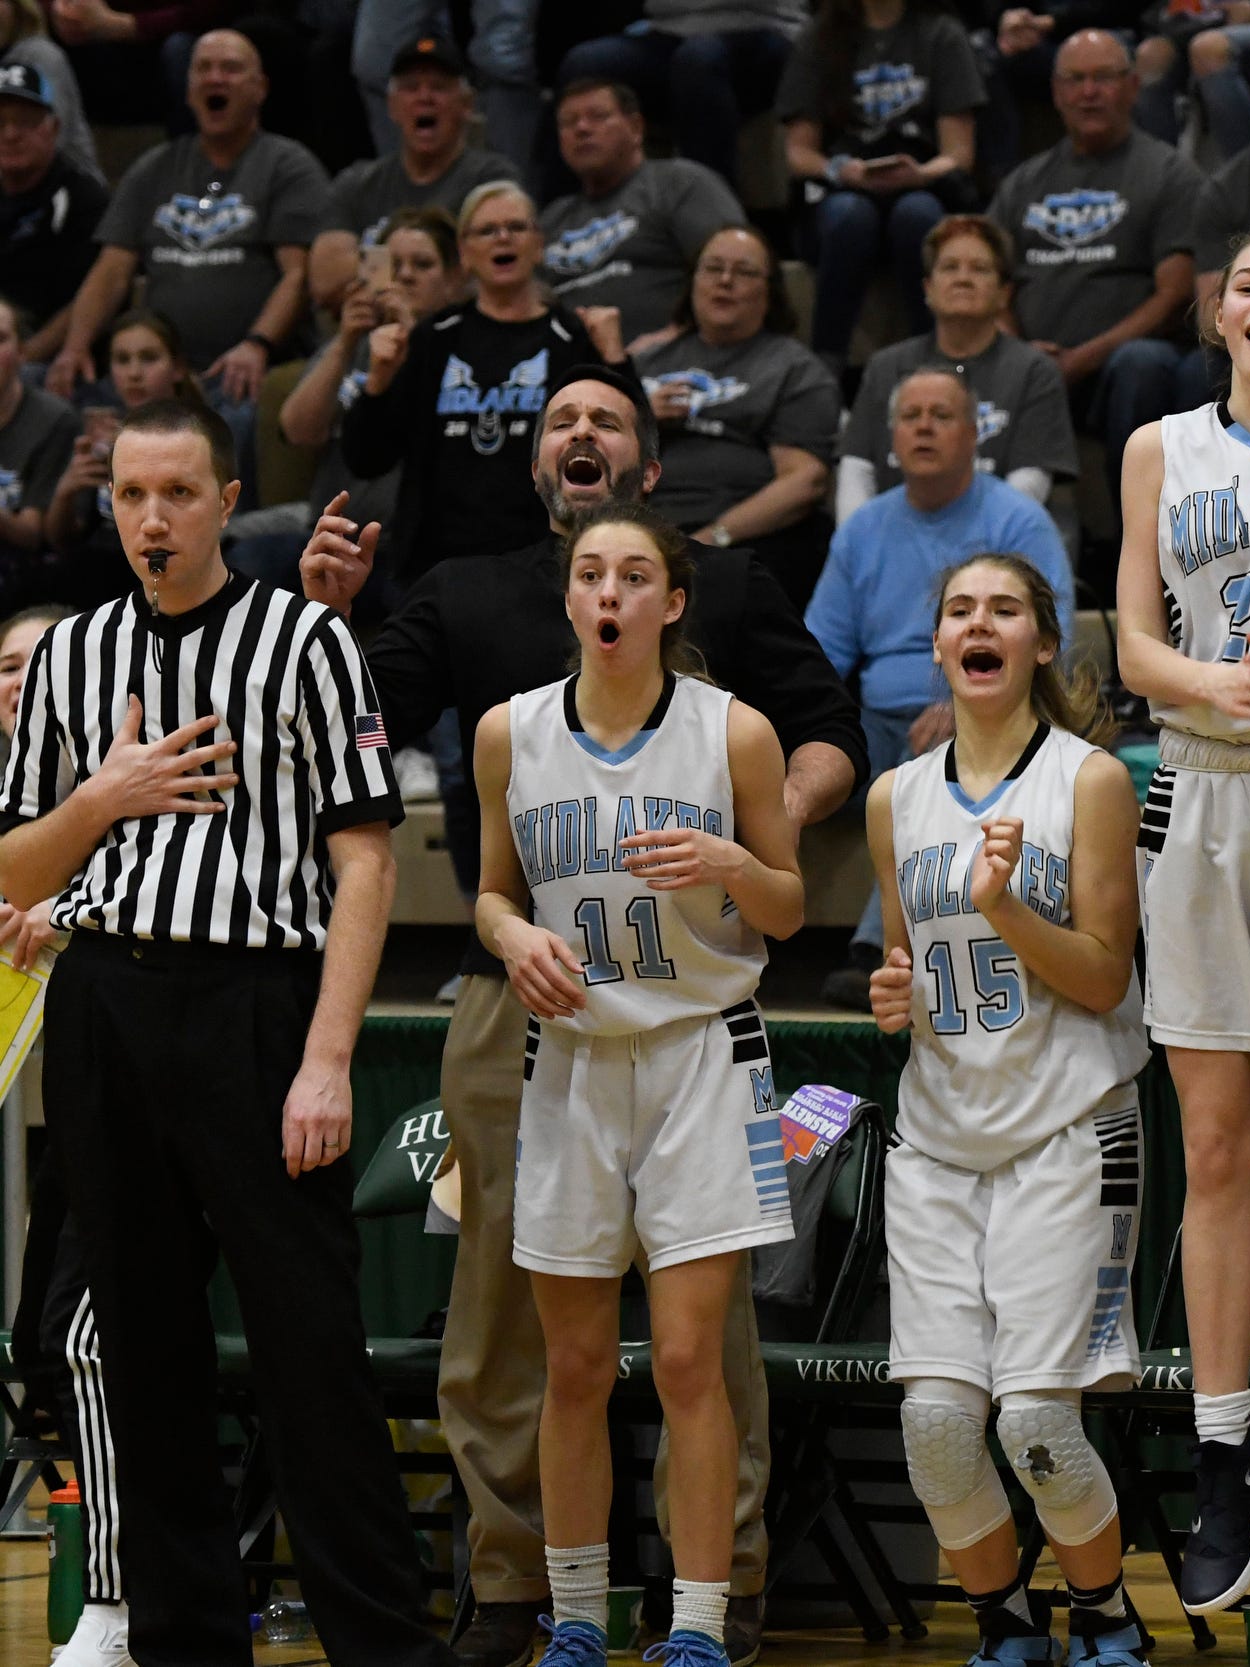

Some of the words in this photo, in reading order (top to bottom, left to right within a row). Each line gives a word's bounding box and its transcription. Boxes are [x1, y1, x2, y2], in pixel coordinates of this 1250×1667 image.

[574, 896, 676, 986] 11
[925, 937, 1024, 1035] 15
[749, 1065, 778, 1114] M
